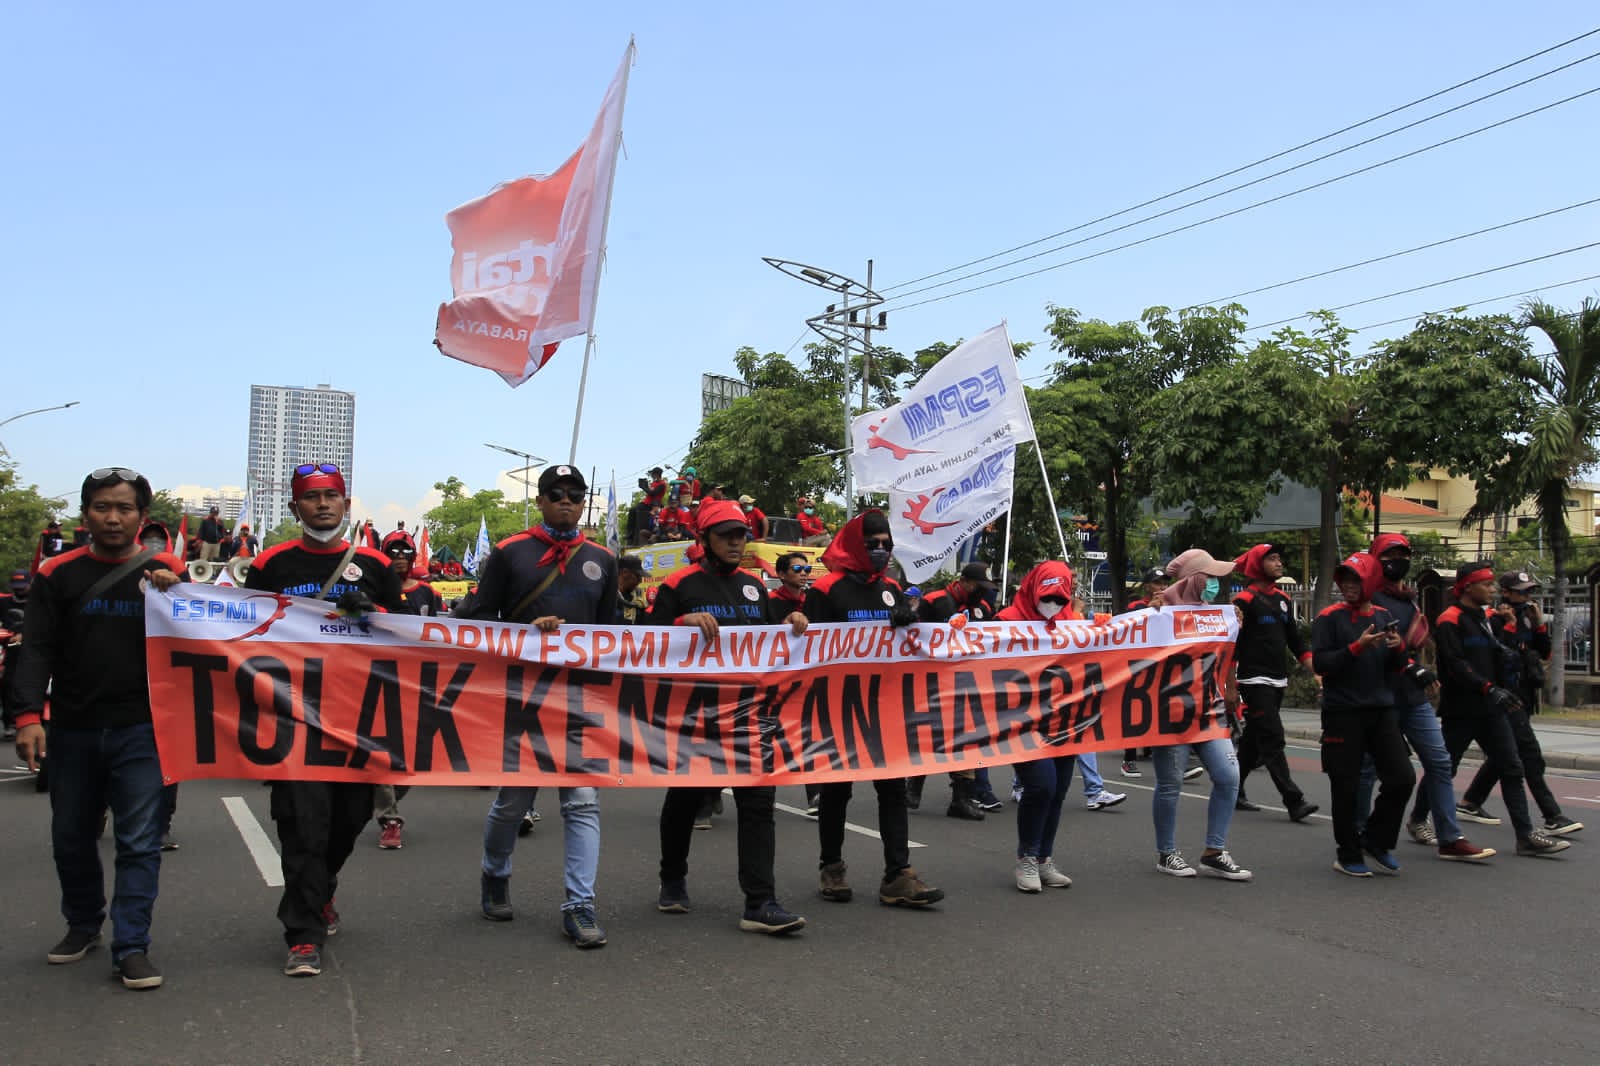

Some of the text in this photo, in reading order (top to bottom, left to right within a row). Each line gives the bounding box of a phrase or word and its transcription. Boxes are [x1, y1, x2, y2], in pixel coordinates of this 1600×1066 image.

[172, 599, 256, 620] FSPMI
[320, 624, 352, 633] KSPI
[540, 629, 669, 668] FSPMI
[678, 631, 790, 668] JAWA
[803, 625, 896, 665] TIMUR
[900, 628, 922, 657] &
[928, 625, 1039, 659] PARTAI
[1046, 614, 1148, 650] BURUH
[170, 650, 476, 772] TOLAK
[502, 664, 888, 775] KENAIKAN
[902, 662, 1104, 766] HARGA
